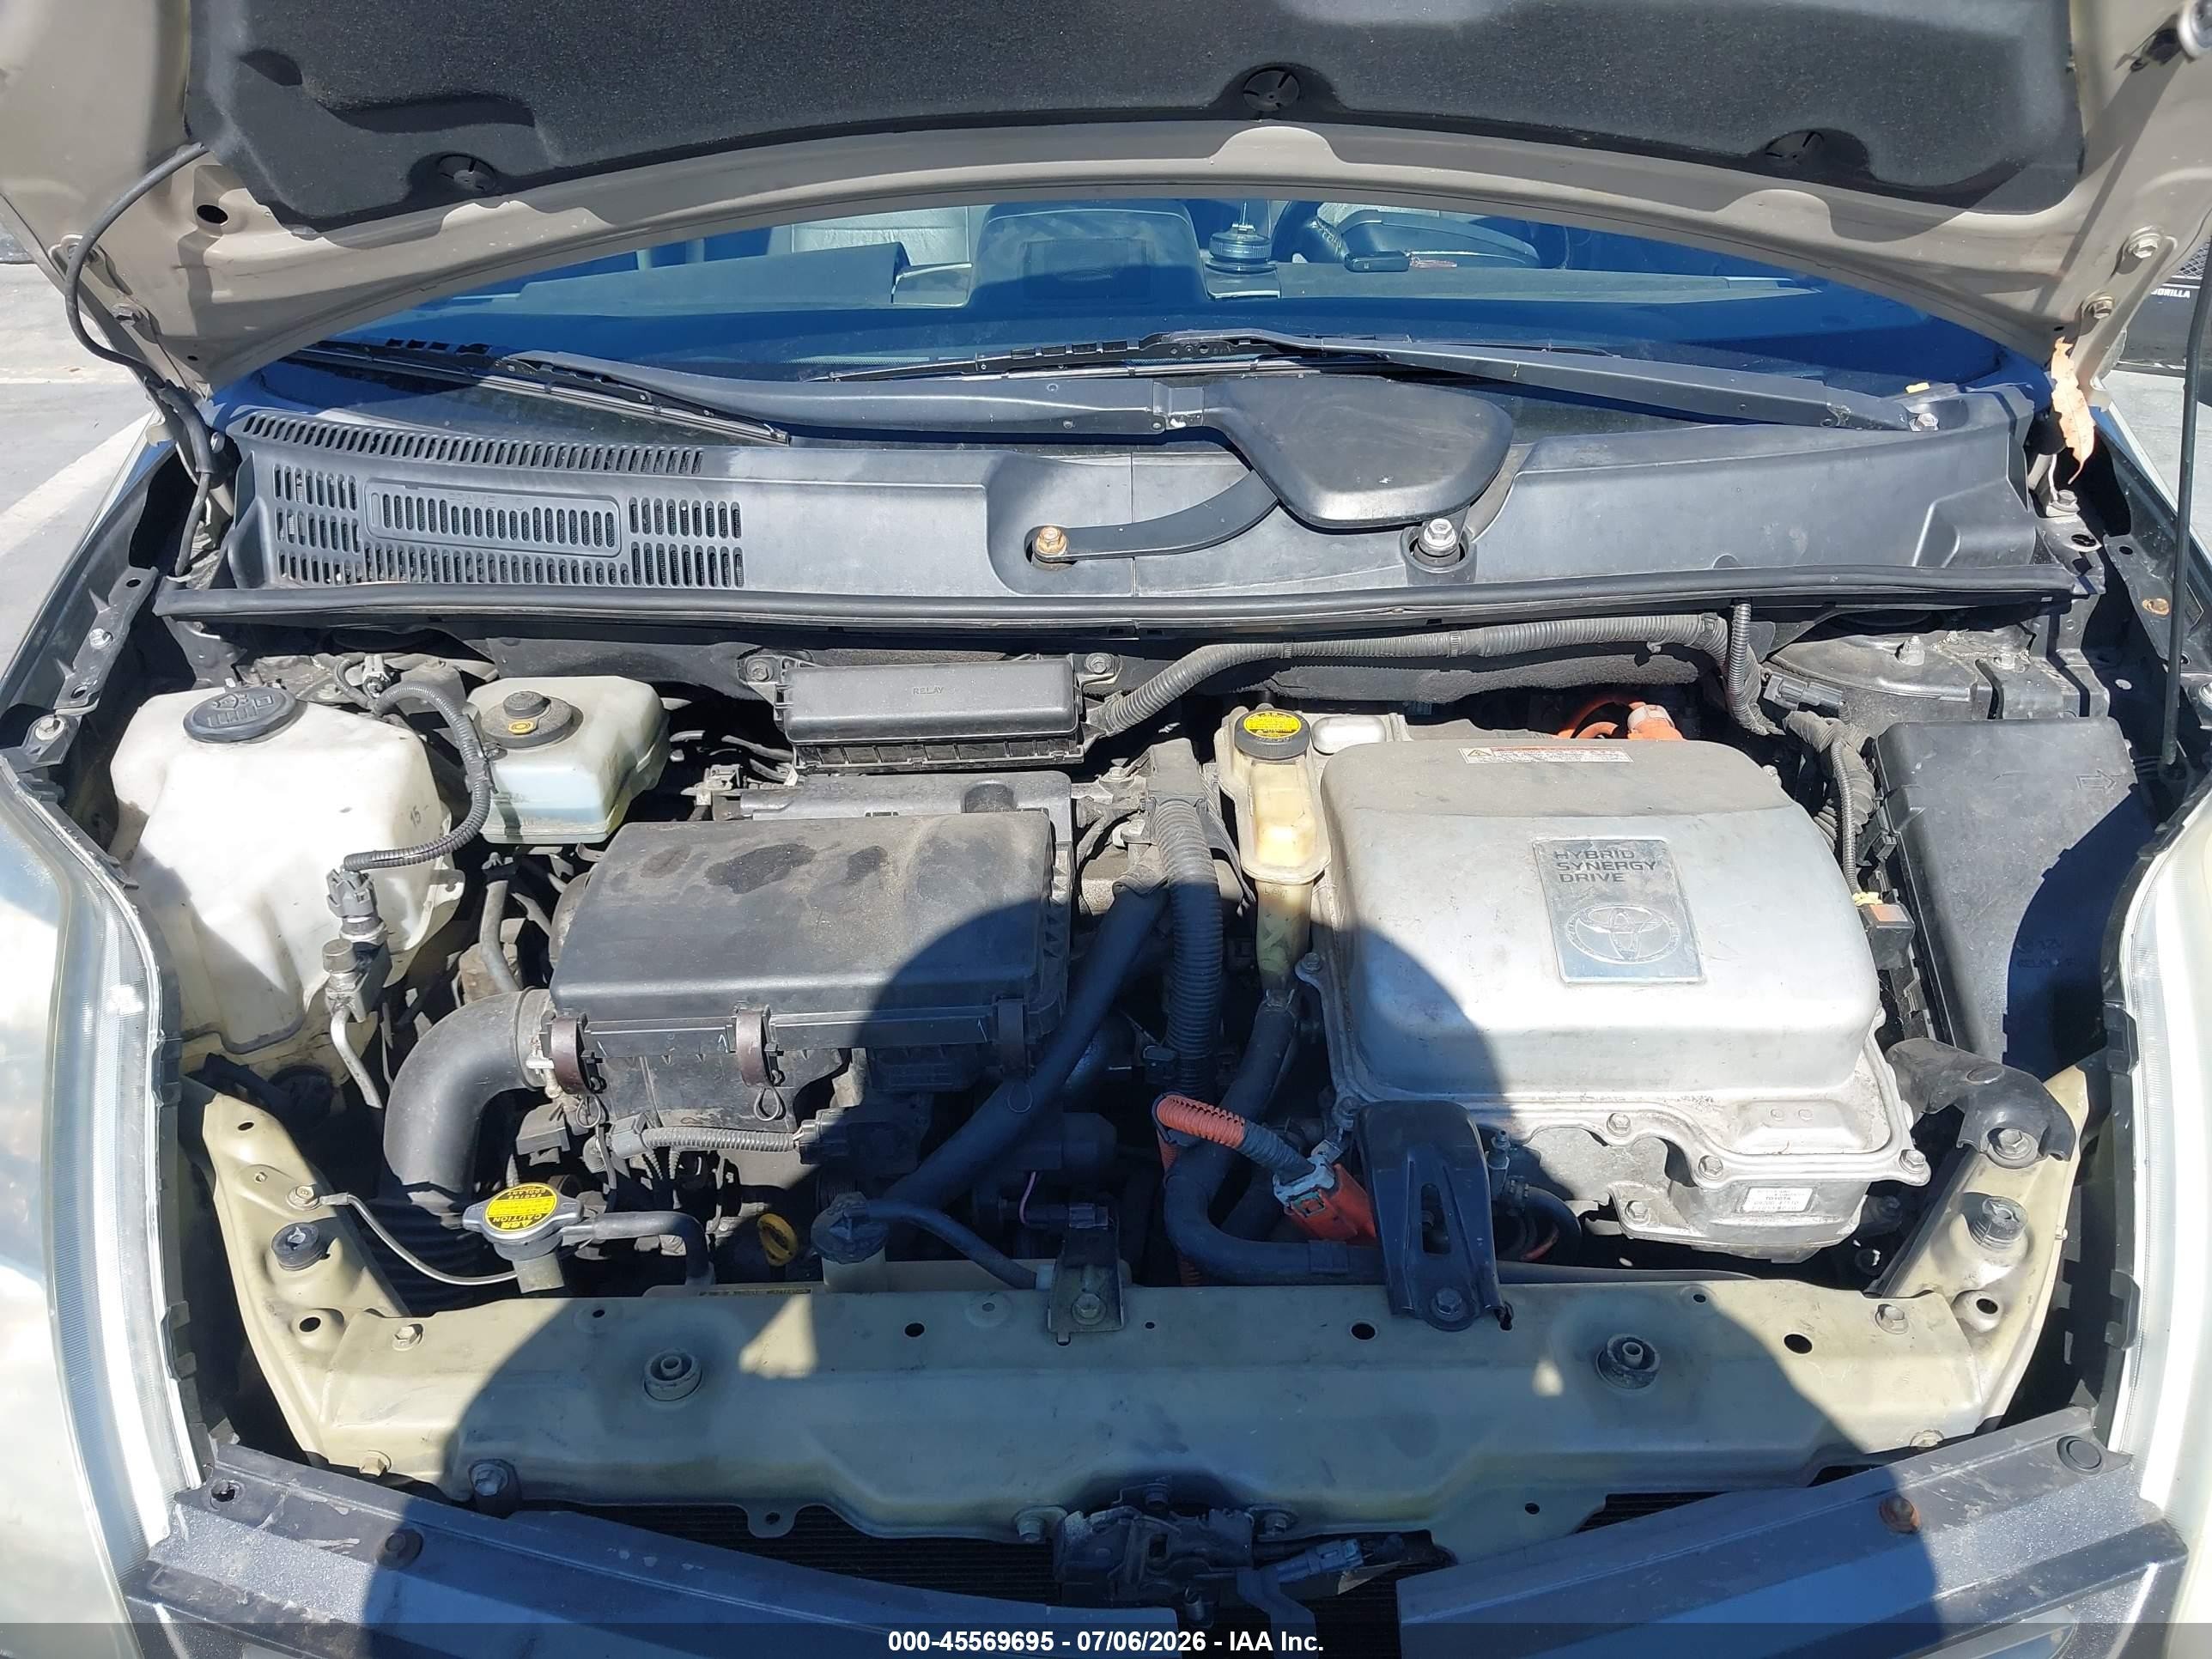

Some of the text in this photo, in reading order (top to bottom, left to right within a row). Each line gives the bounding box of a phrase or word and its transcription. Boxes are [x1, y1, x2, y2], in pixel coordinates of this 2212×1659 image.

[913, 686, 945, 695] RELAY
[1553, 849, 1635, 860] HYBRID
[1557, 860, 1656, 872] SYNERGY
[1559, 872, 1626, 883] DRIVE
[493, 1213, 543, 1222] CAUTION
